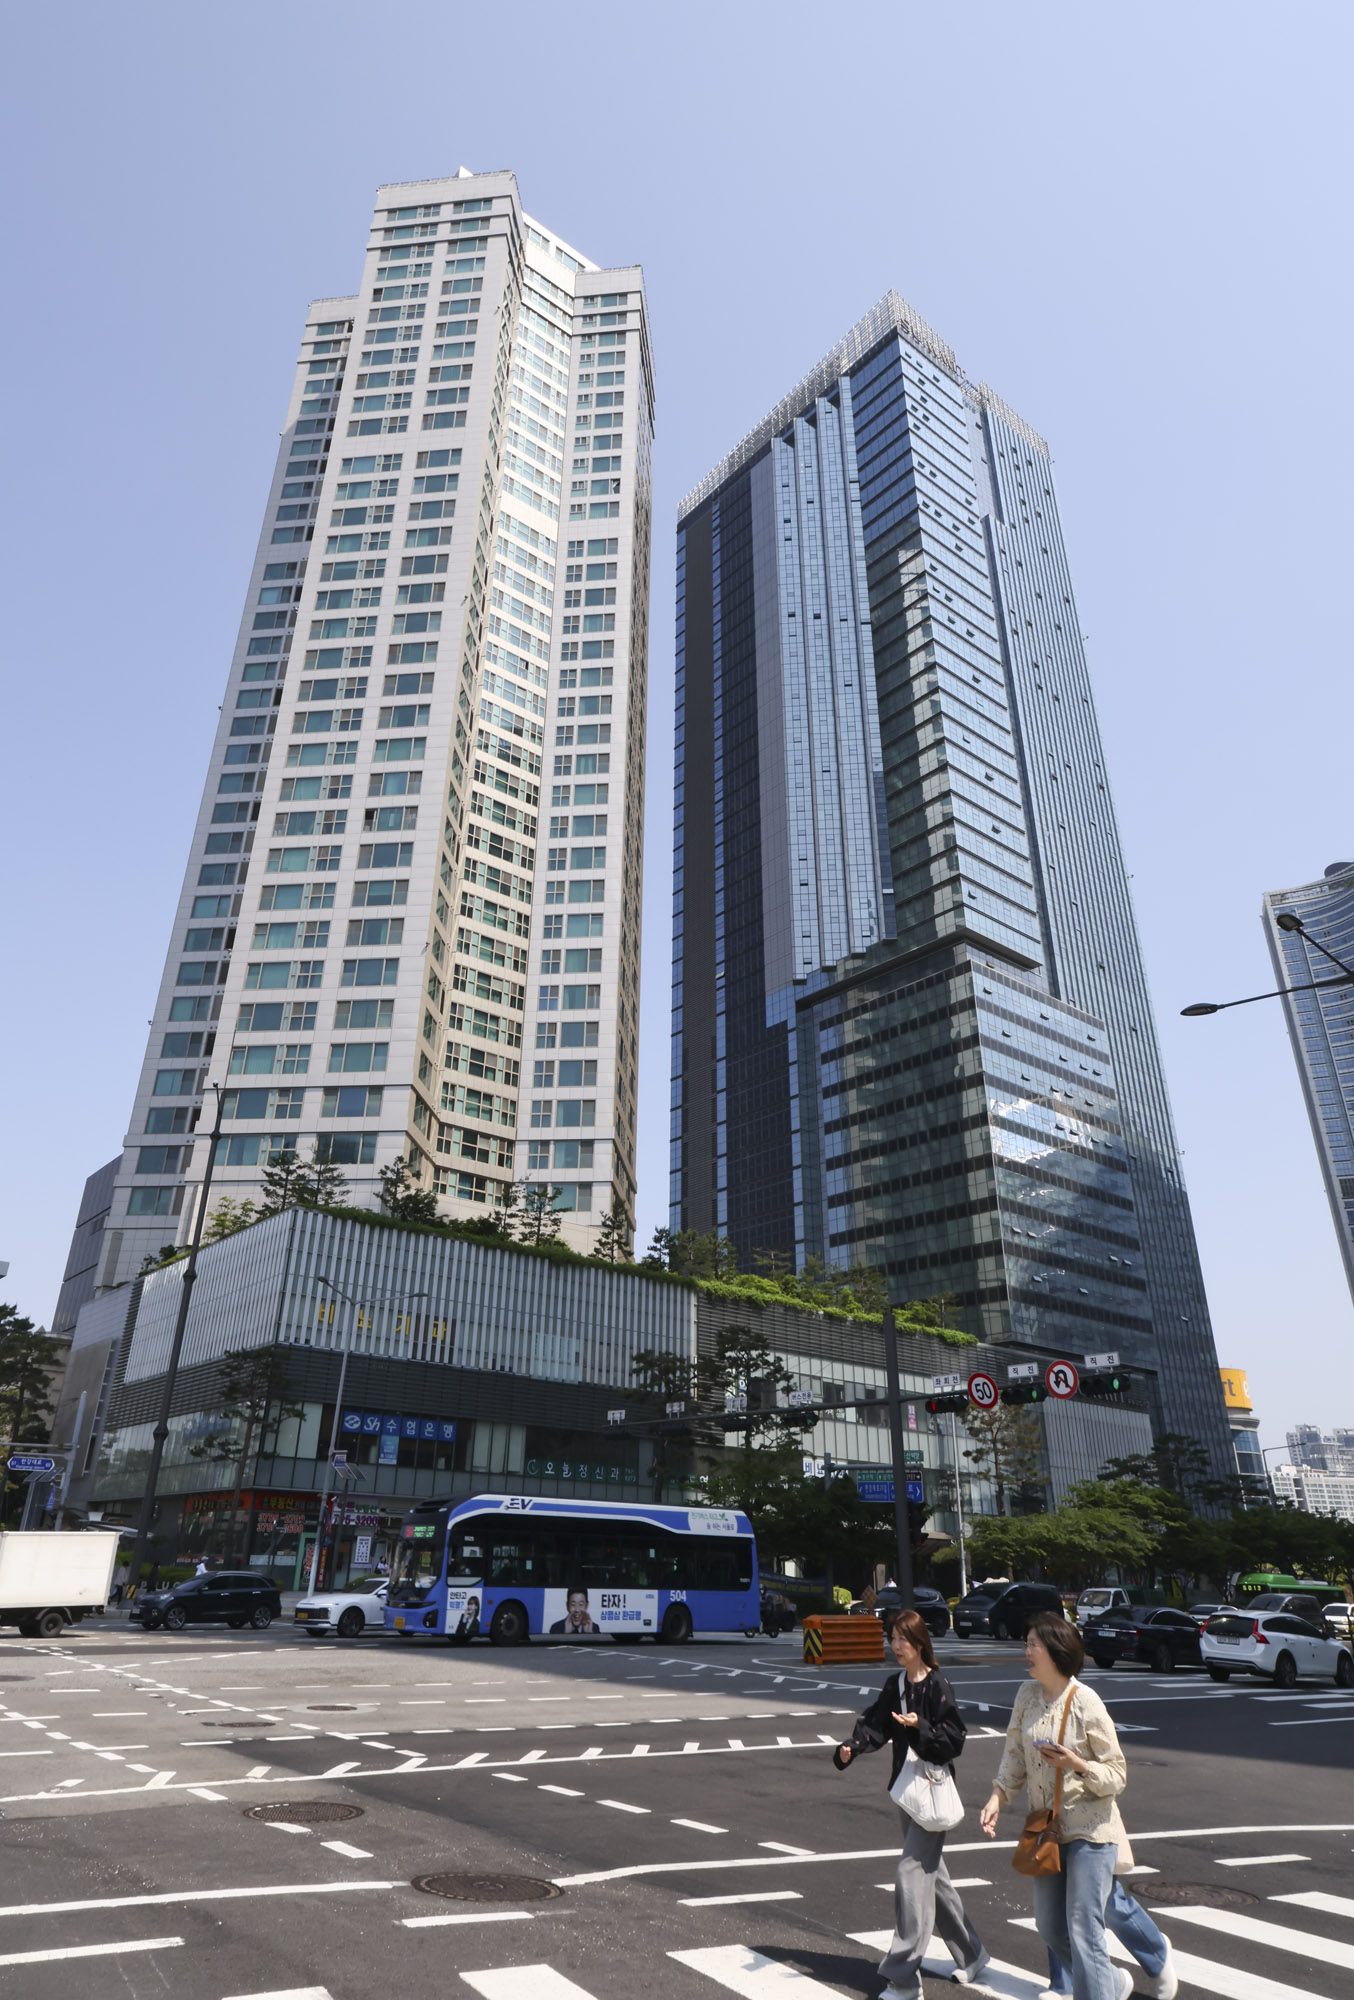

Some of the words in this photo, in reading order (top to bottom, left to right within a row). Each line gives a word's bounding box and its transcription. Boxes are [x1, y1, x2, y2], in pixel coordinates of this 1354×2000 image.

[935, 1376, 959, 1386] 좌회전
[791, 1391, 812, 1401] 버스전용
[975, 1382, 992, 1400] 50
[364, 1416, 380, 1431] Sh
[386, 1419, 453, 1438] 수협은행
[544, 1462, 620, 1481] 오늘정신과
[507, 1497, 533, 1510] EV
[601, 1594, 626, 1608] 타자!
[670, 1590, 687, 1602] 504
